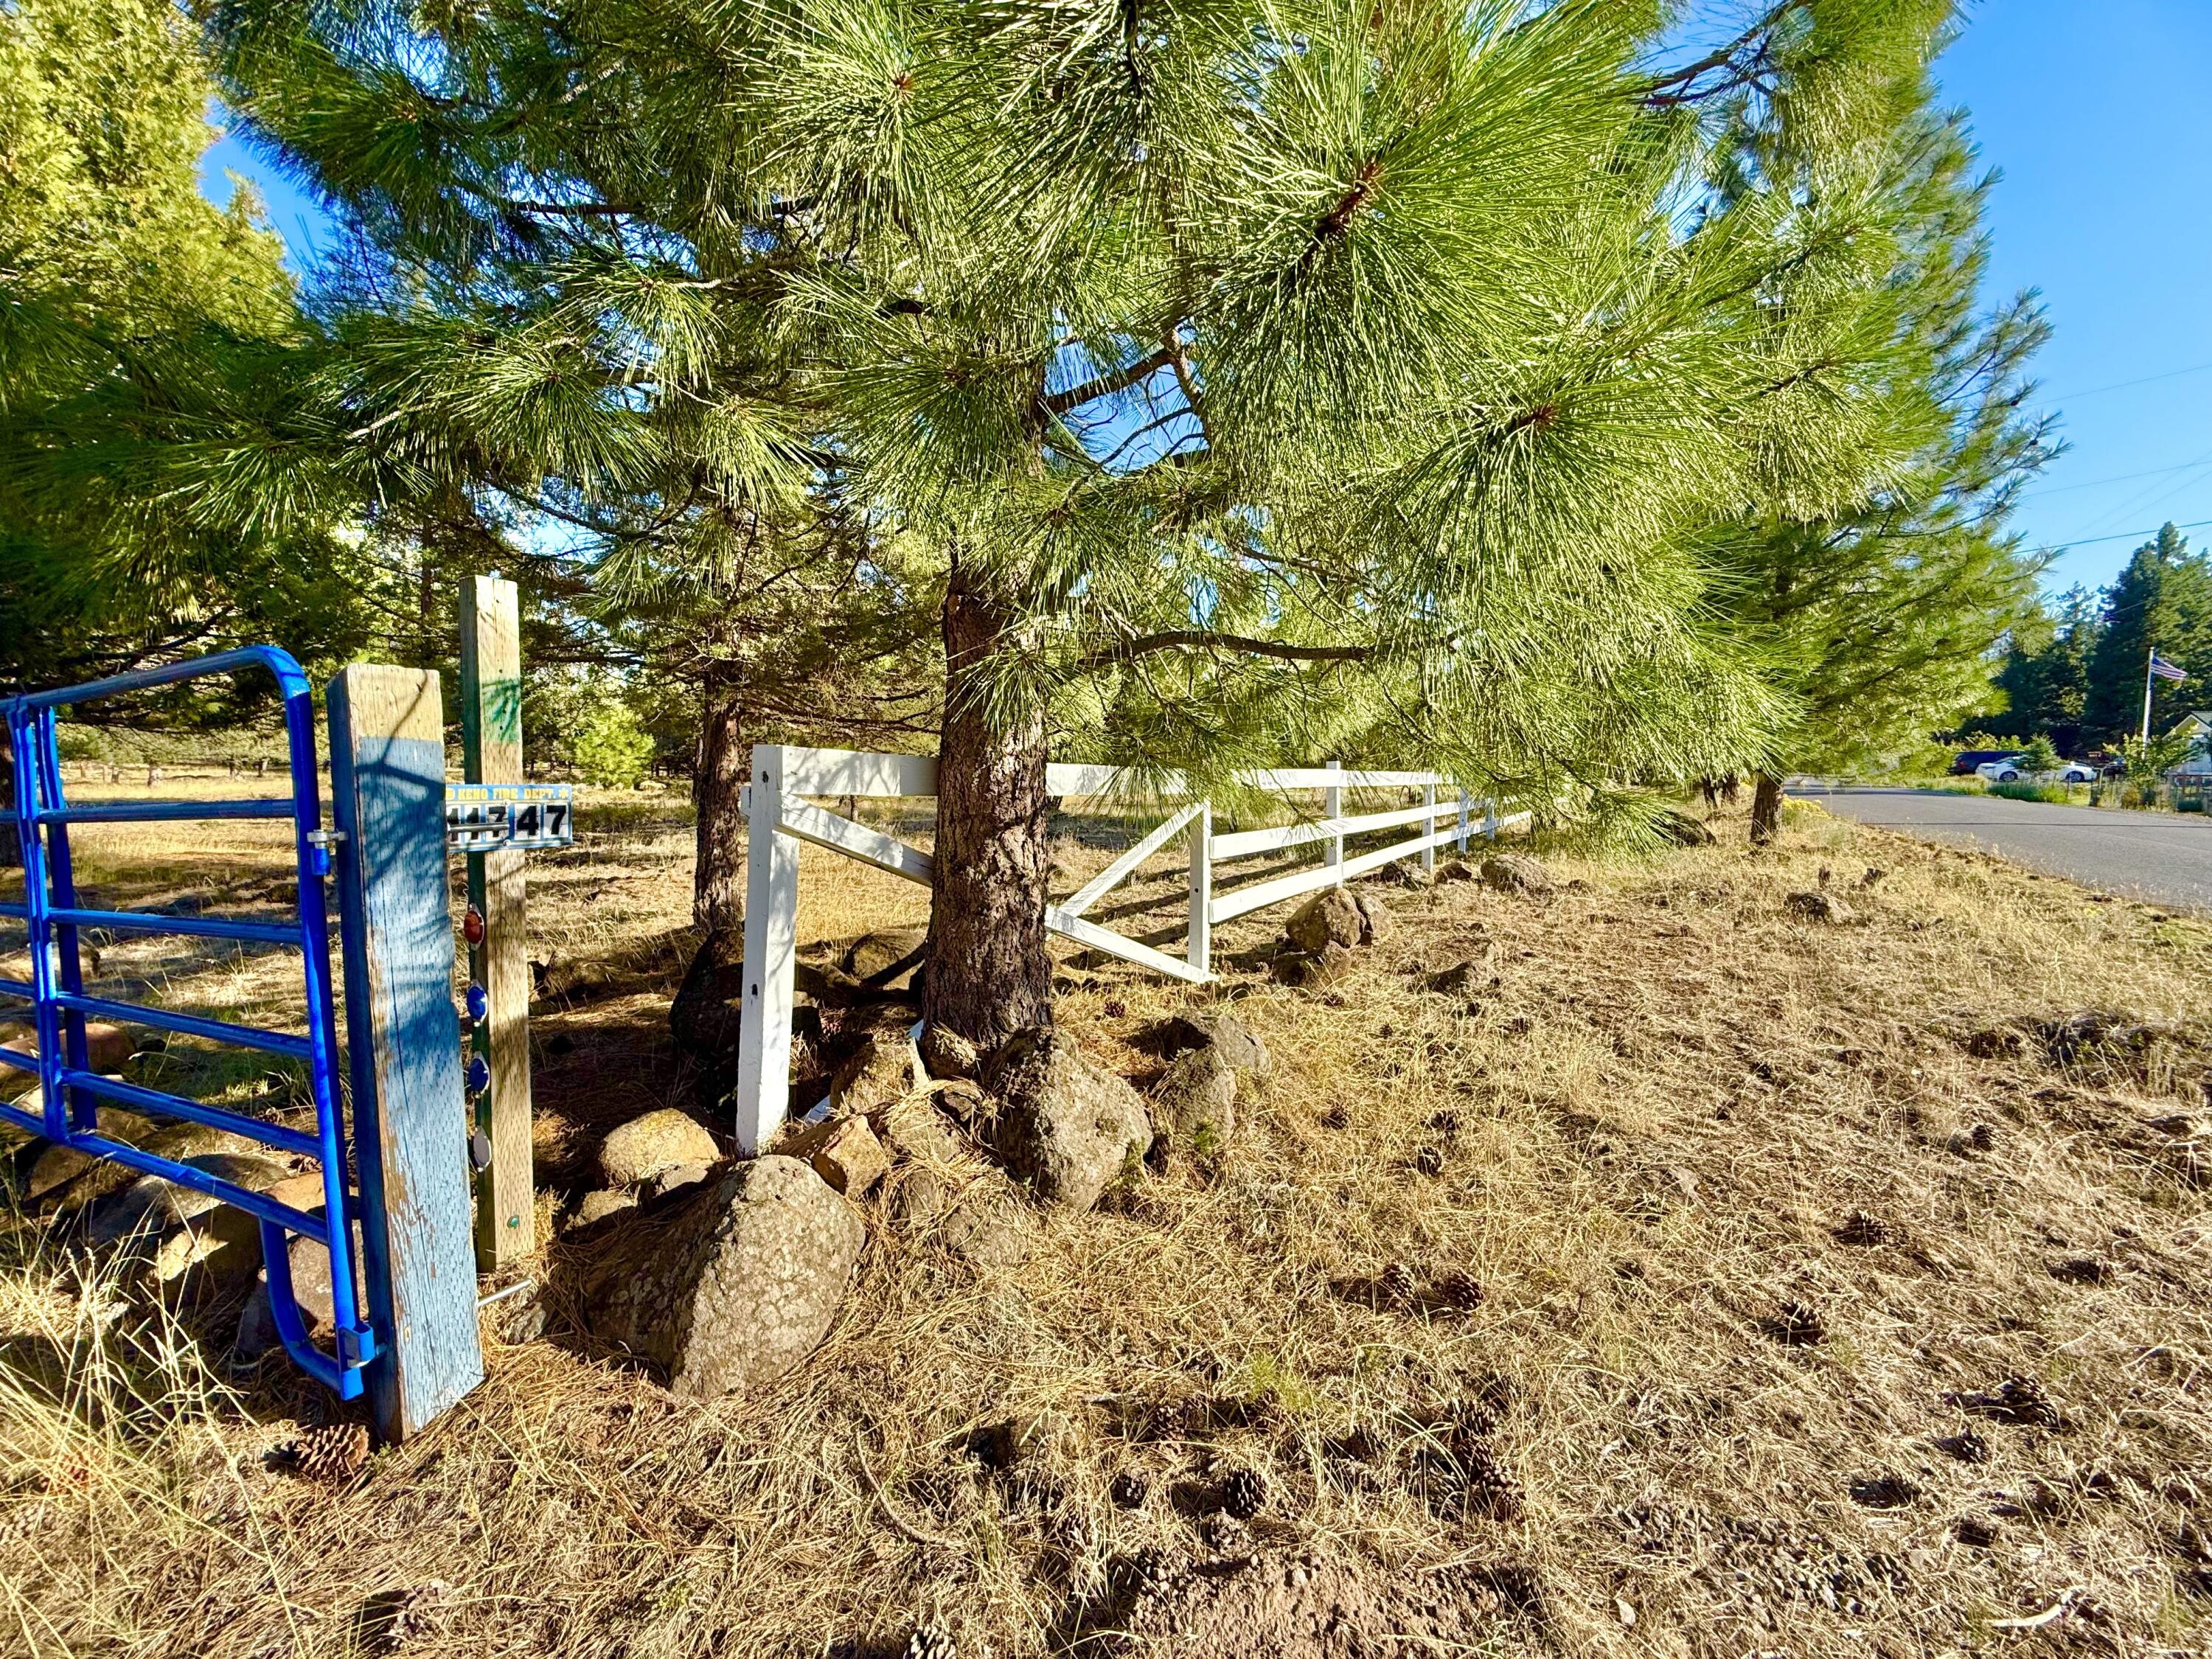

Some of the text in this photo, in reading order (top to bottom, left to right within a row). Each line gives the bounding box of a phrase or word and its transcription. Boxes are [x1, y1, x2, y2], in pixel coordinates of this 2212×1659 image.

[458, 788, 556, 800] KENO FIRE DEPT.
